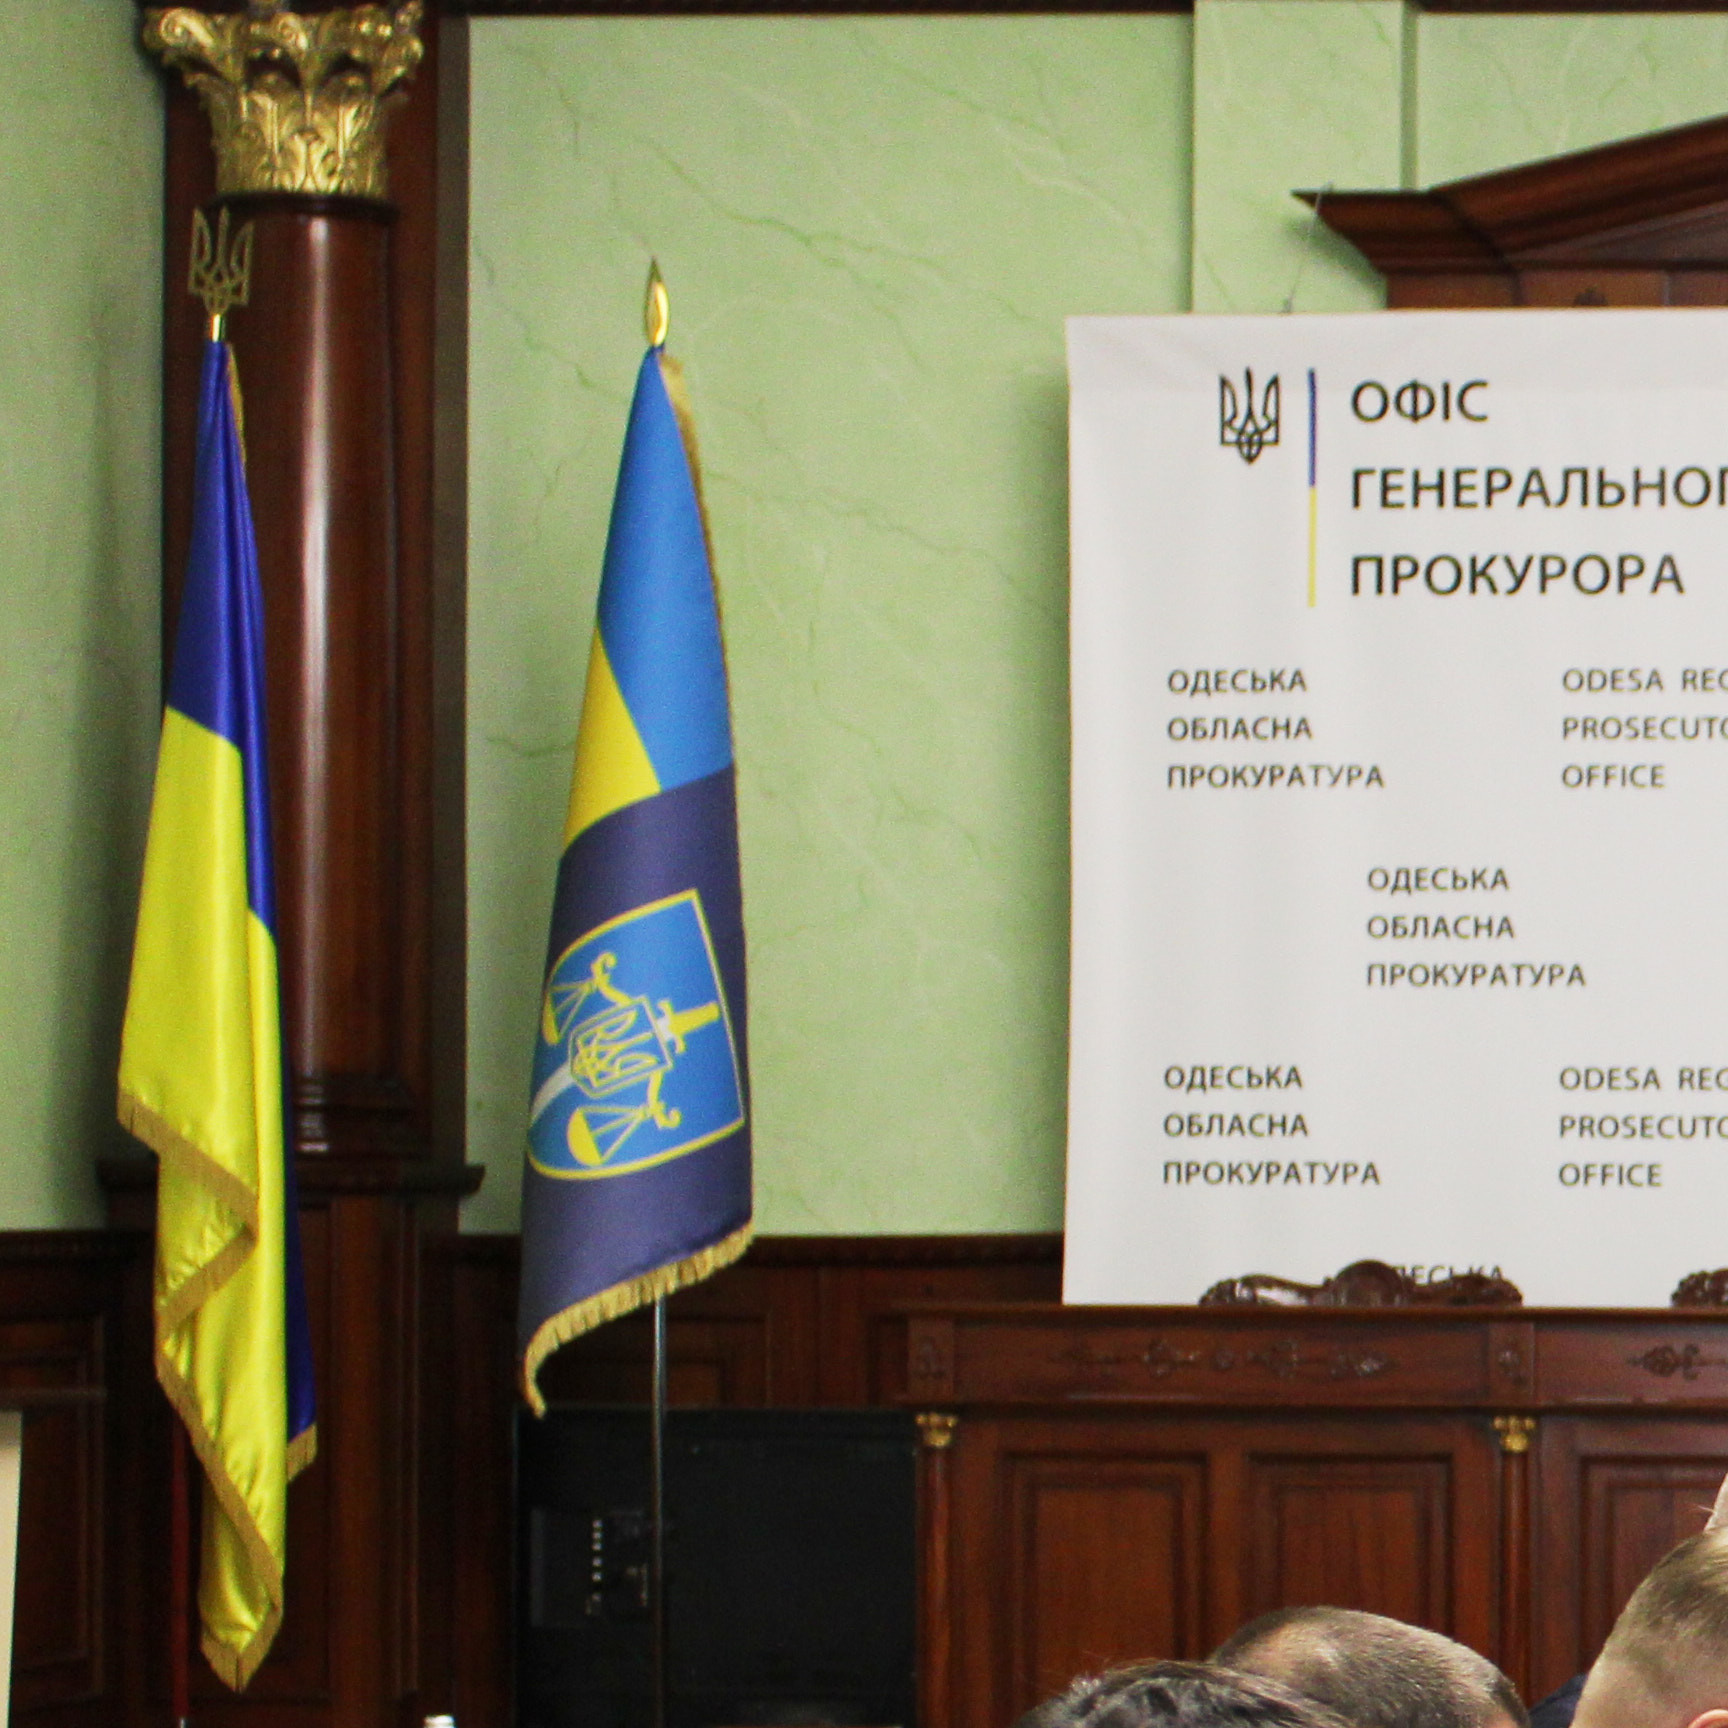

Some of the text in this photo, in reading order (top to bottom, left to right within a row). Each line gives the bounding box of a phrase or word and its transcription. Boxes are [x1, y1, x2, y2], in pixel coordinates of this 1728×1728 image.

[1349, 378, 1490, 425] ОФІС
[1350, 552, 1686, 598] ПРОКУРОРА
[1166, 667, 1308, 699] ОДЕСЬКА
[1561, 667, 1665, 694] ODESA
[1166, 715, 1313, 743] ОБЛАСНА
[1166, 763, 1385, 790] ПРОКУРАТУРА
[1560, 763, 1665, 790] OFFICE
[1366, 866, 1510, 896] ОДЕСЬКА
[1366, 914, 1516, 940] ОБЛАСНА
[1366, 962, 1587, 988] ПРОКУРАТУРА
[1163, 1064, 1304, 1095] ОДЕСЬКА
[1558, 1066, 1662, 1092] ODESA
[1162, 1112, 1309, 1139] ОБЛАСНА
[1162, 1160, 1381, 1186] ПРОКУРАТУРА
[1557, 1162, 1662, 1188] OFFICE
